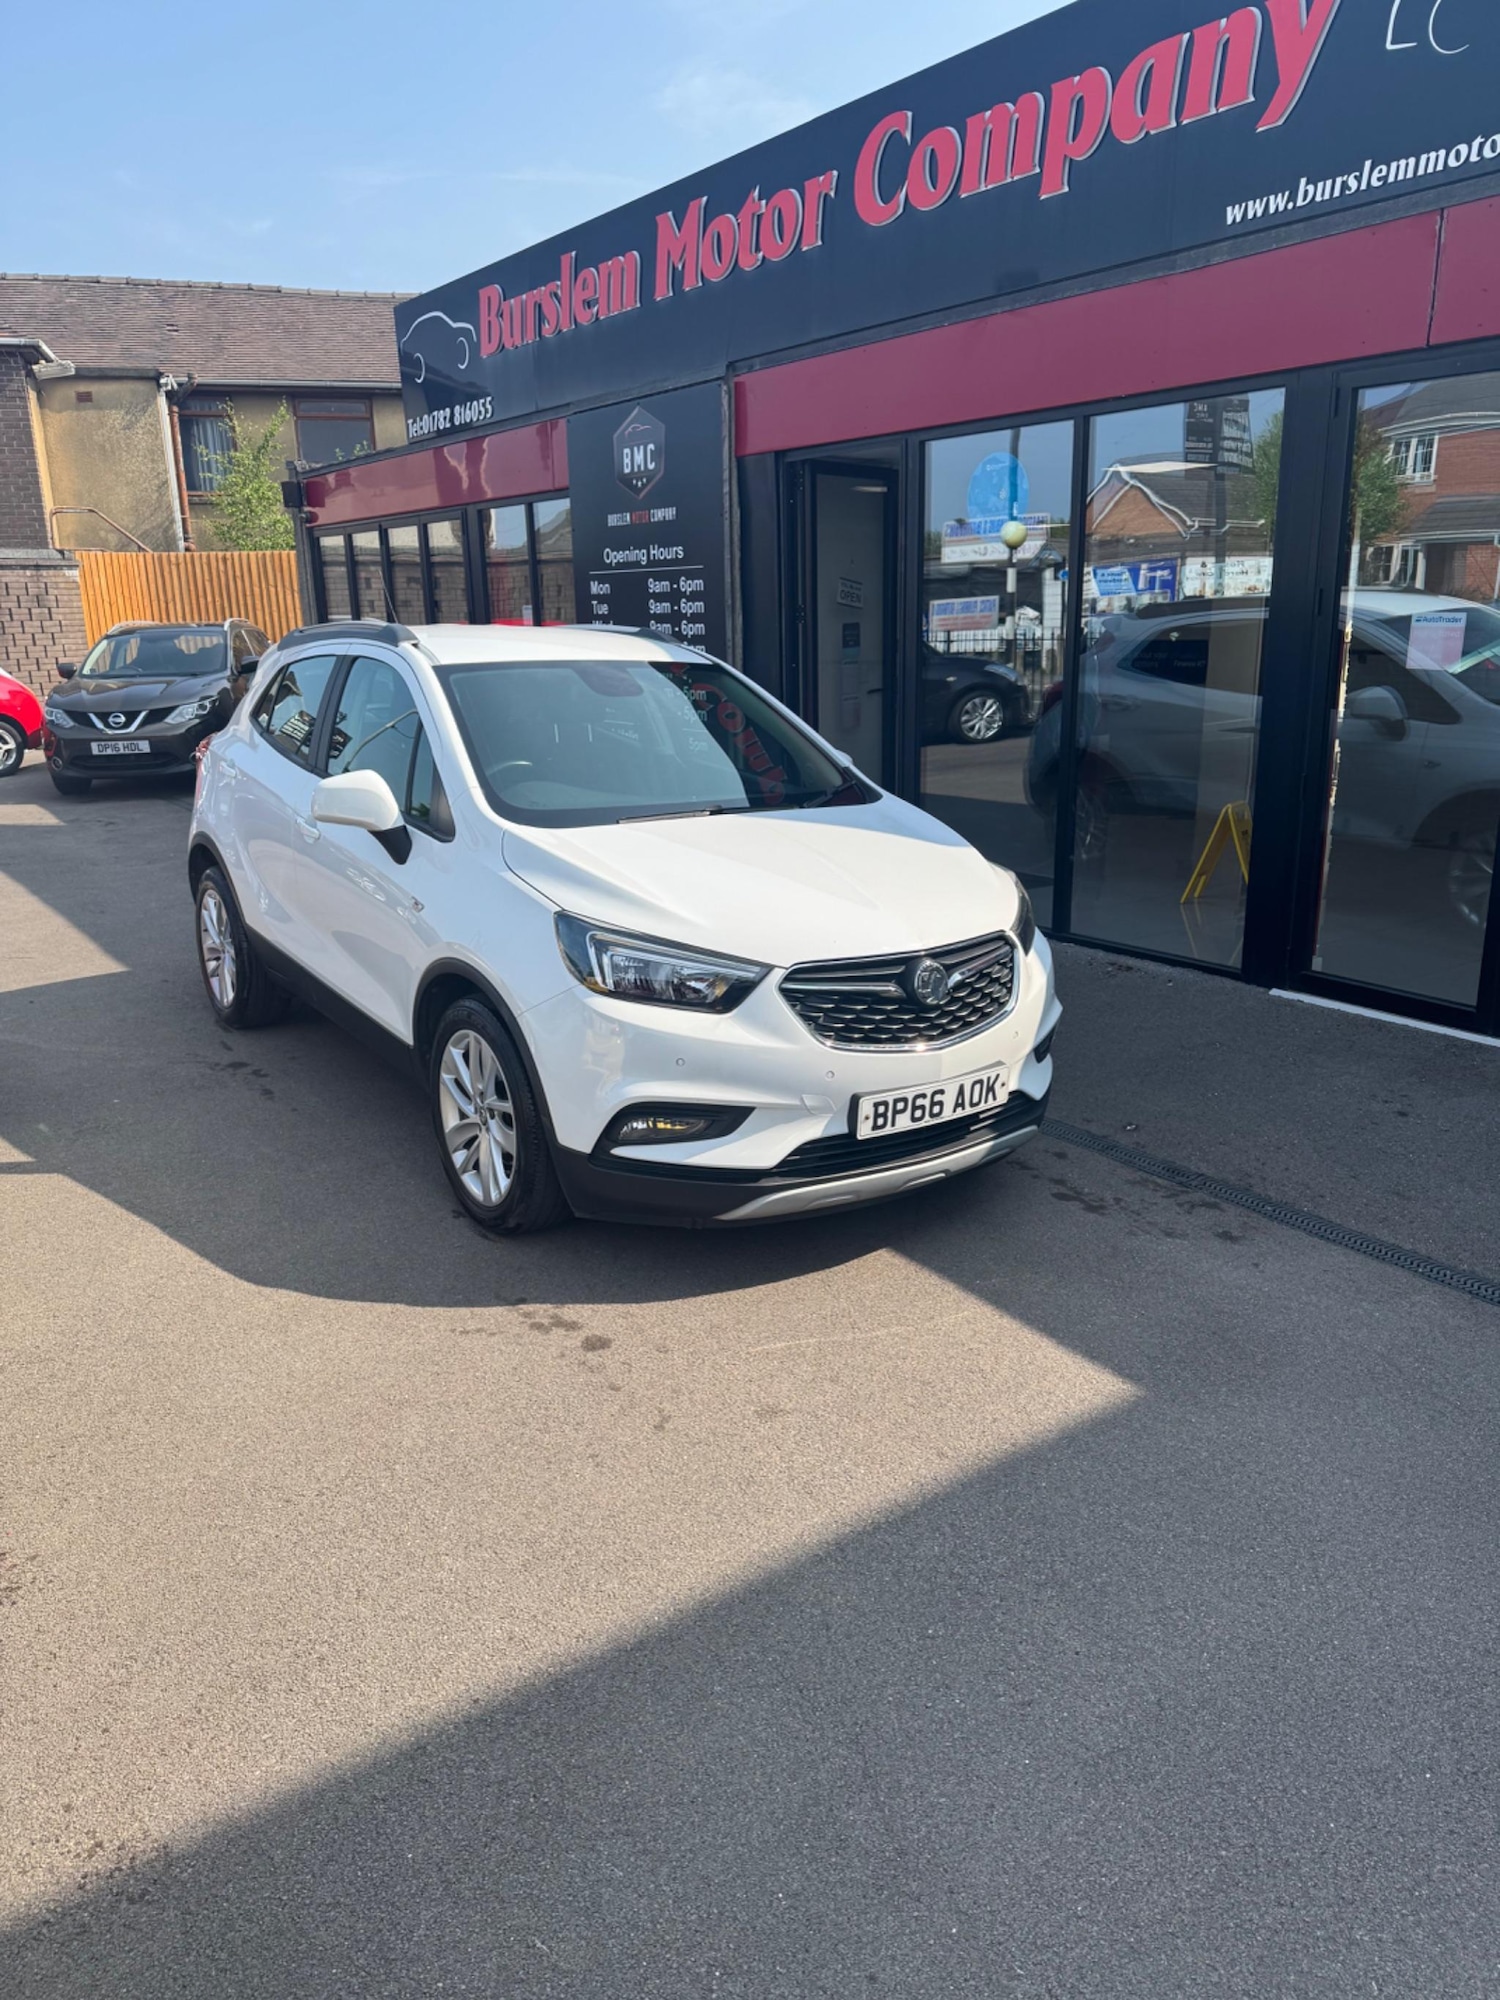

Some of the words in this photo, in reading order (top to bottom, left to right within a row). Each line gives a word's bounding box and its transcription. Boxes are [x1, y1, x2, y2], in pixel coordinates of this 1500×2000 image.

[478, 250, 641, 359] Burslem
[653, 170, 838, 301] Motor
[853, 0, 1341, 227] Company
[1225, 133, 1500, 226] www.burslemmoto
[407, 407, 451, 438] Tel:01782
[453, 396, 493, 426] 816055
[623, 443, 655, 473] BMC
[603, 546, 647, 566] Opening
[650, 544, 685, 560] Hours
[590, 580, 611, 595] Mon
[647, 578, 670, 593] 9am
[679, 576, 704, 595] 6pm
[591, 600, 609, 615] Tue
[648, 599, 671, 614] 9am
[680, 598, 705, 617] 6pm
[681, 620, 706, 638] 6pm
[97, 742, 121, 753] DP16
[122, 741, 144, 752] HDL
[871, 1088, 946, 1131] BP66
[952, 1073, 1000, 1114] AOK
